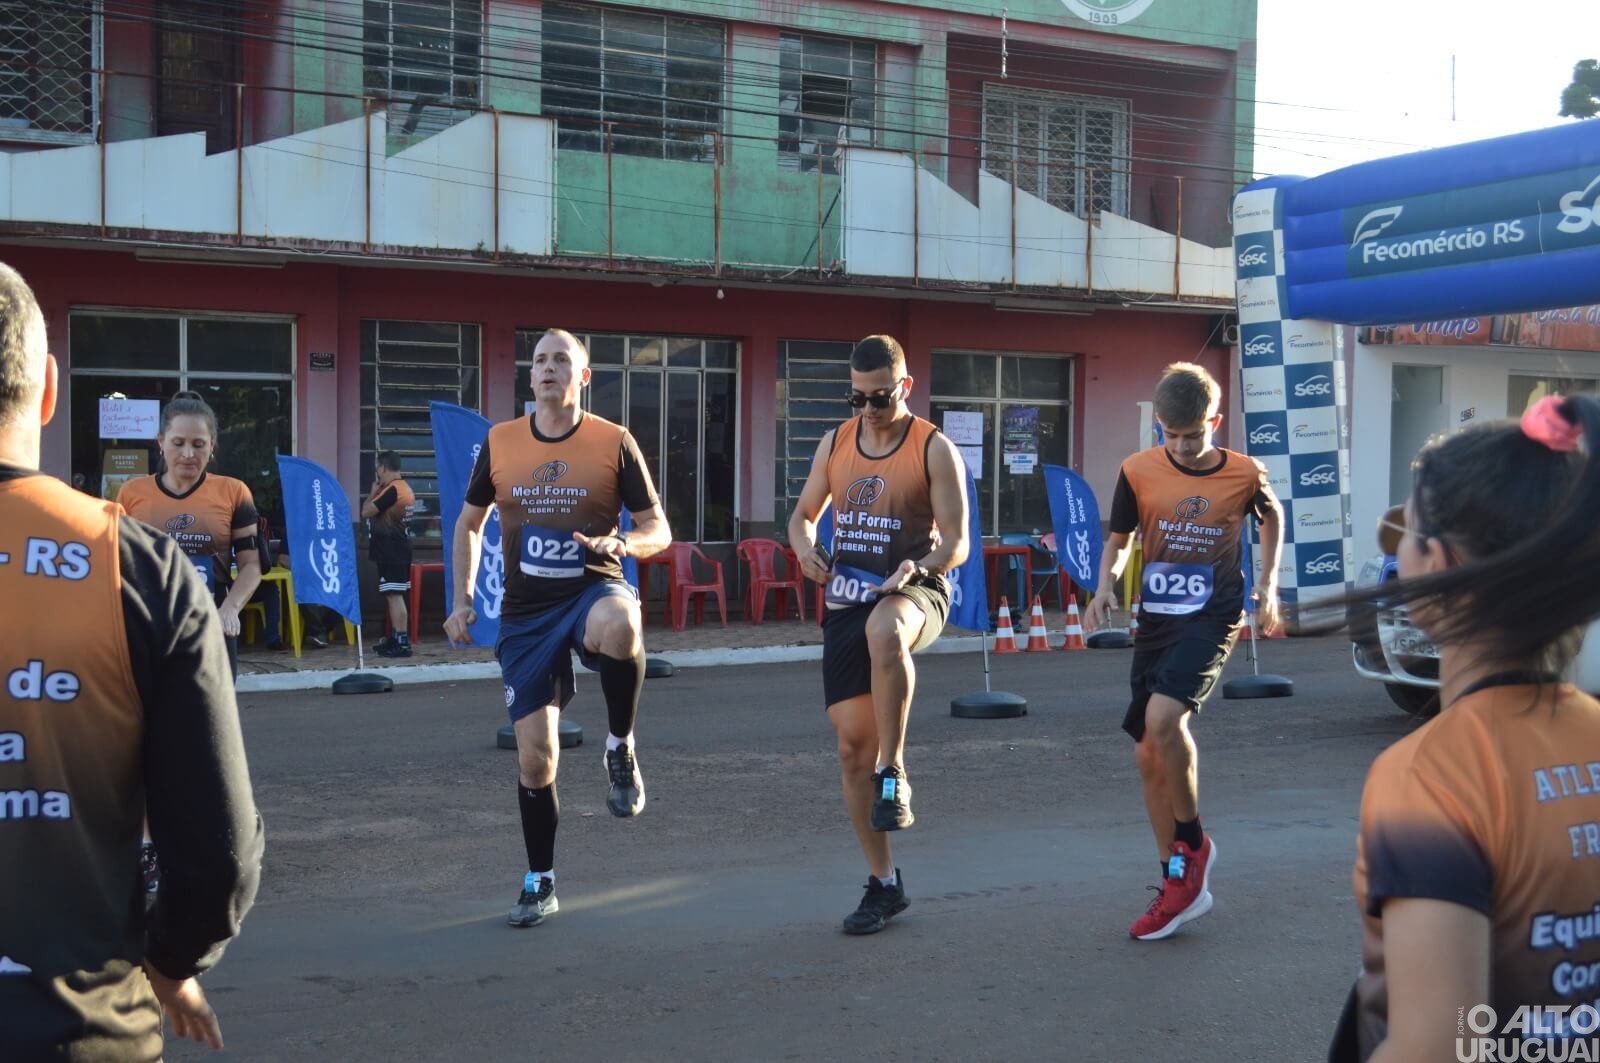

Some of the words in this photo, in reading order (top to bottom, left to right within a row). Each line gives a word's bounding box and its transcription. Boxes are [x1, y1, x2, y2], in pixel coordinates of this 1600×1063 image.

[1088, 11, 1118, 24] 1909
[1363, 227, 1486, 263] Fecomércio
[1493, 219, 1525, 245] RS
[1238, 252, 1267, 267] Sesc
[1244, 341, 1275, 356] Sesc
[1294, 382, 1331, 397] Sesc
[1249, 431, 1280, 444] Sesc
[1300, 472, 1336, 486] Sesc
[512, 485, 540, 497] Med
[544, 485, 588, 497] Forma
[520, 497, 578, 506] Academia
[836, 509, 854, 525] ed
[857, 511, 902, 530] Forma
[835, 527, 892, 542] Academia
[1158, 519, 1182, 532] Med
[1185, 522, 1223, 536] Forma
[175, 532, 212, 541] Forma
[1164, 532, 1216, 545] Academia
[527, 535, 580, 561] 022
[837, 542, 867, 552] SEBERI
[872, 545, 884, 554] RS
[1075, 529, 1091, 580] Sesc
[25, 538, 91, 580] RS
[320, 538, 340, 594] Sesc
[1305, 559, 1341, 575] Sesc
[831, 575, 872, 603] 007
[1148, 572, 1207, 596] 026
[7, 661, 80, 700] de
